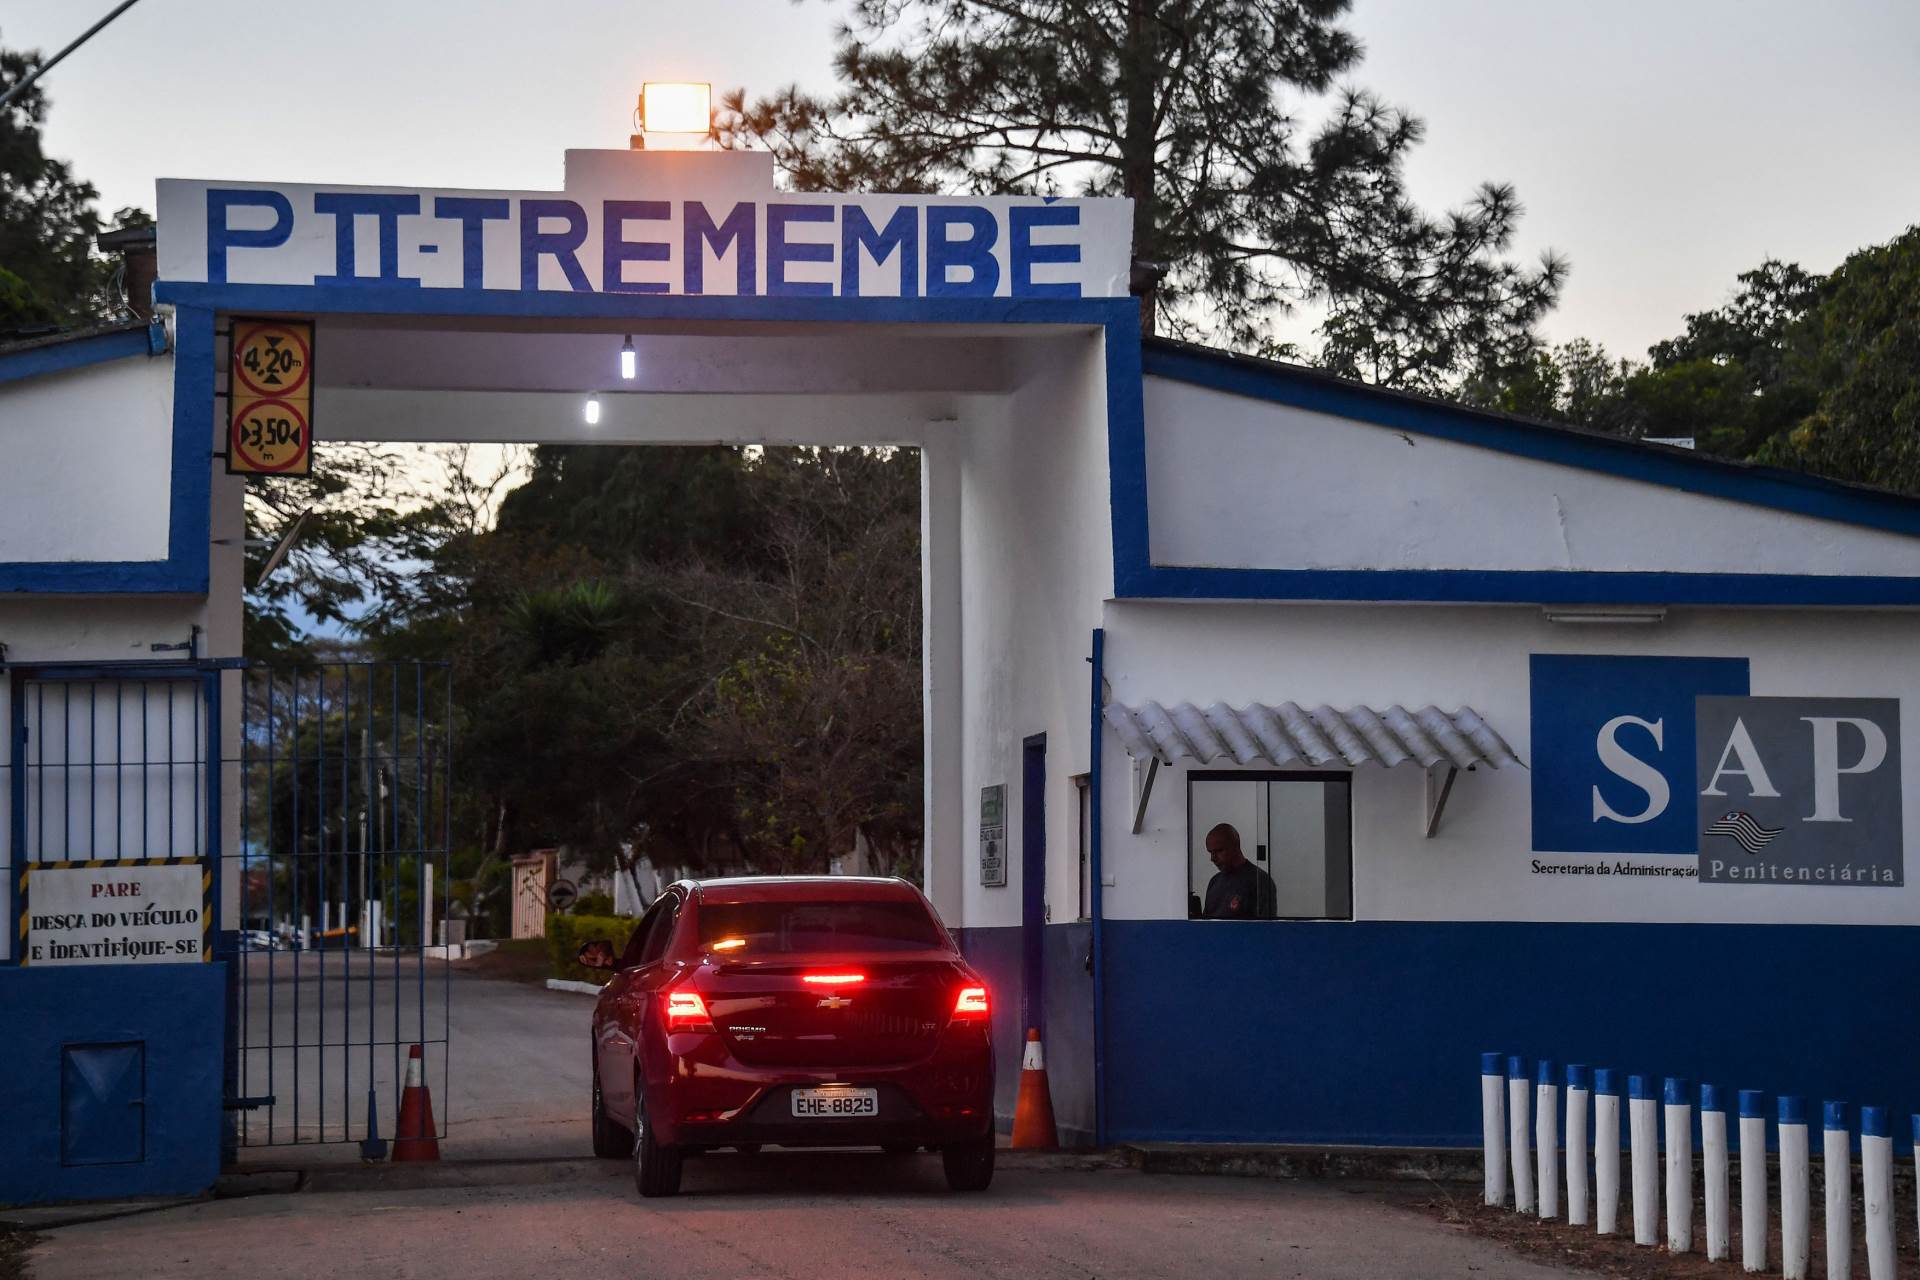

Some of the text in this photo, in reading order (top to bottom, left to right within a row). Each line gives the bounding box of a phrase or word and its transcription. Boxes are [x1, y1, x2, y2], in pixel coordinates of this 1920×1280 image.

[249, 418, 290, 451] 3,50
[1592, 714, 1888, 824] SAP
[1531, 859, 1594, 875] Secretaria
[1596, 861, 1610, 875] da
[1710, 860, 1895, 882] Penitenciária
[91, 882, 142, 898] PARE
[31, 902, 198, 931] DESÇA DO VEÍCULO
[31, 946, 43, 960] E
